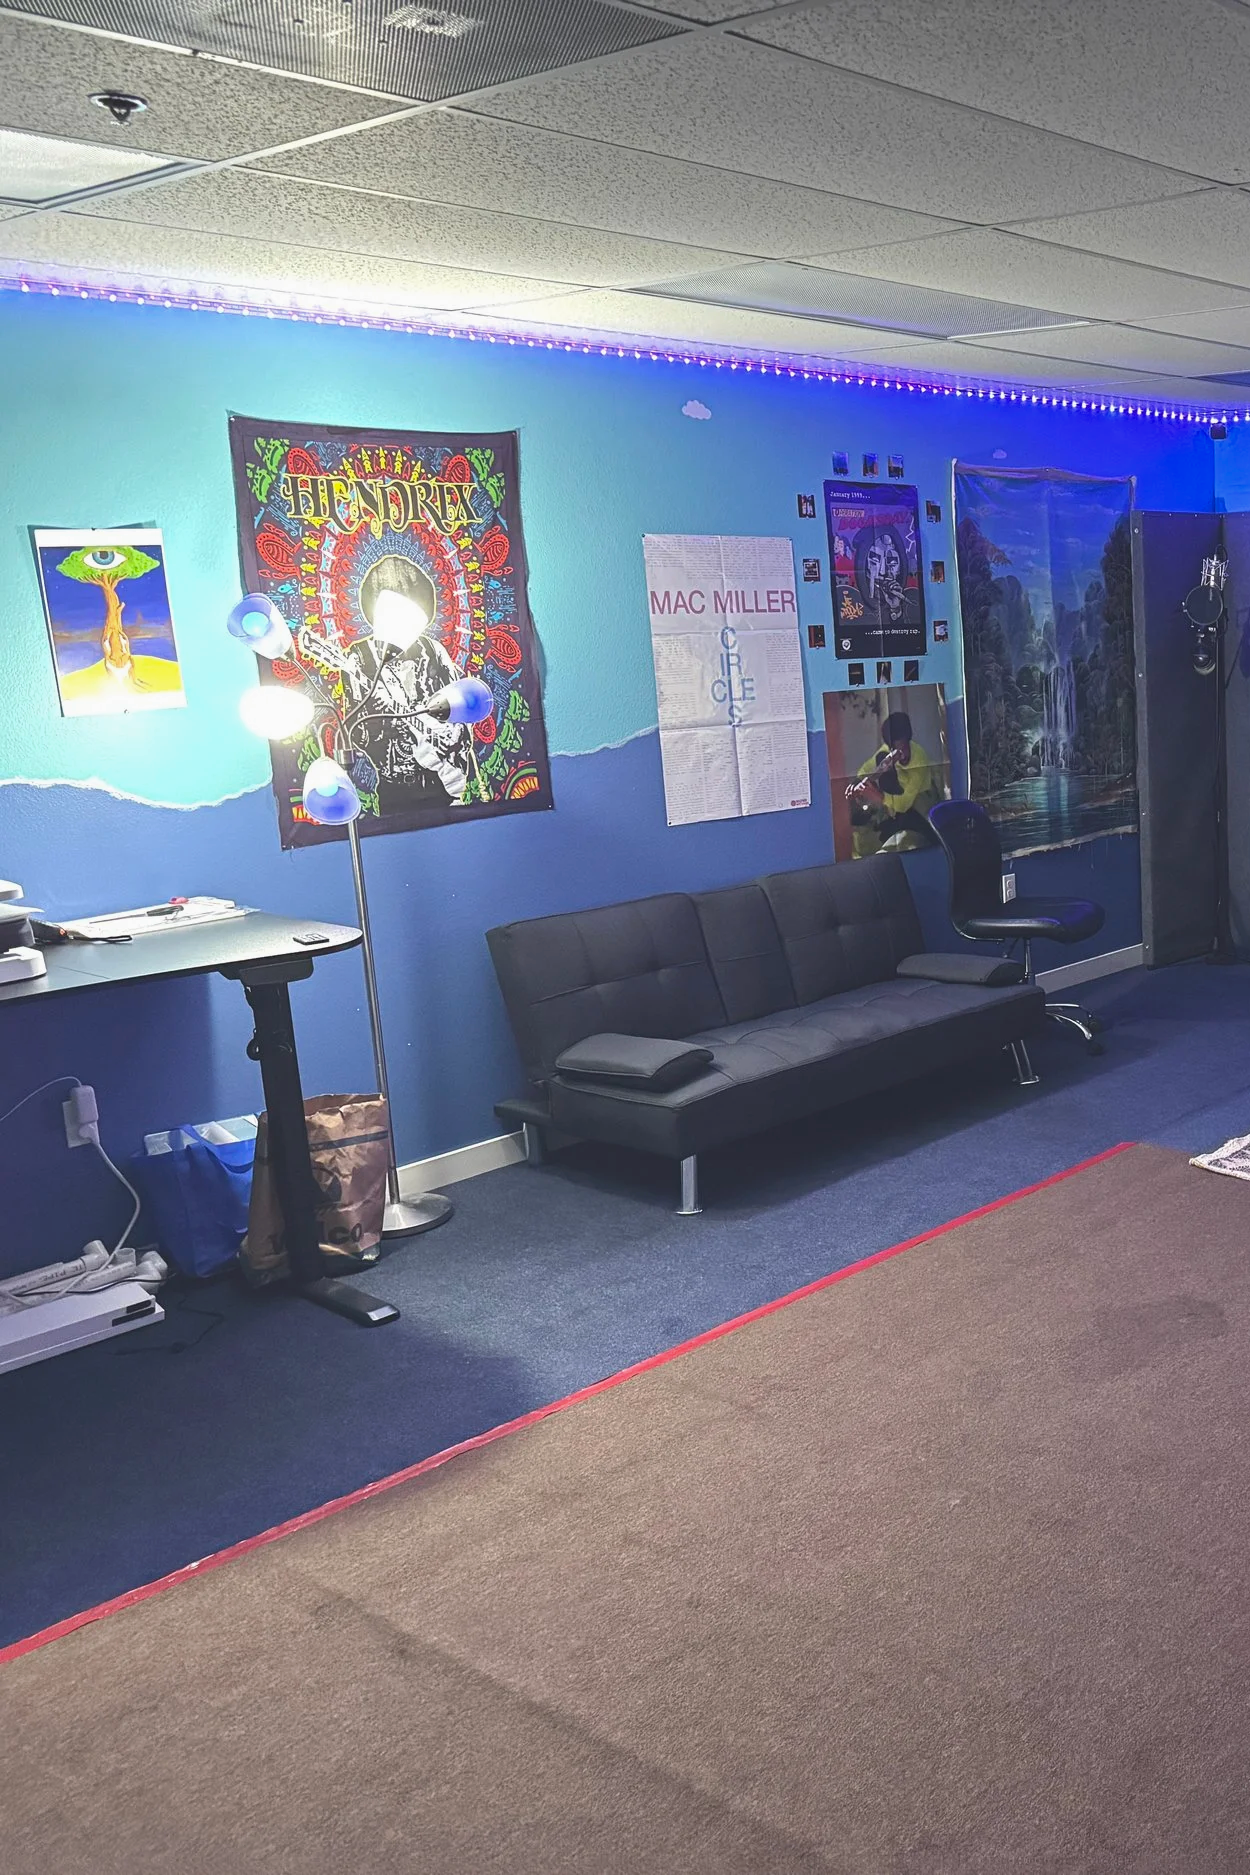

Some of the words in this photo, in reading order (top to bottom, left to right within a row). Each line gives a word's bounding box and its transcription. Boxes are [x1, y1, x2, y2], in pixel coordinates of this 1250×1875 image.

[281, 473, 482, 538] HENDRIX
[650, 590, 706, 614] MAC
[713, 590, 796, 614] MILLER
